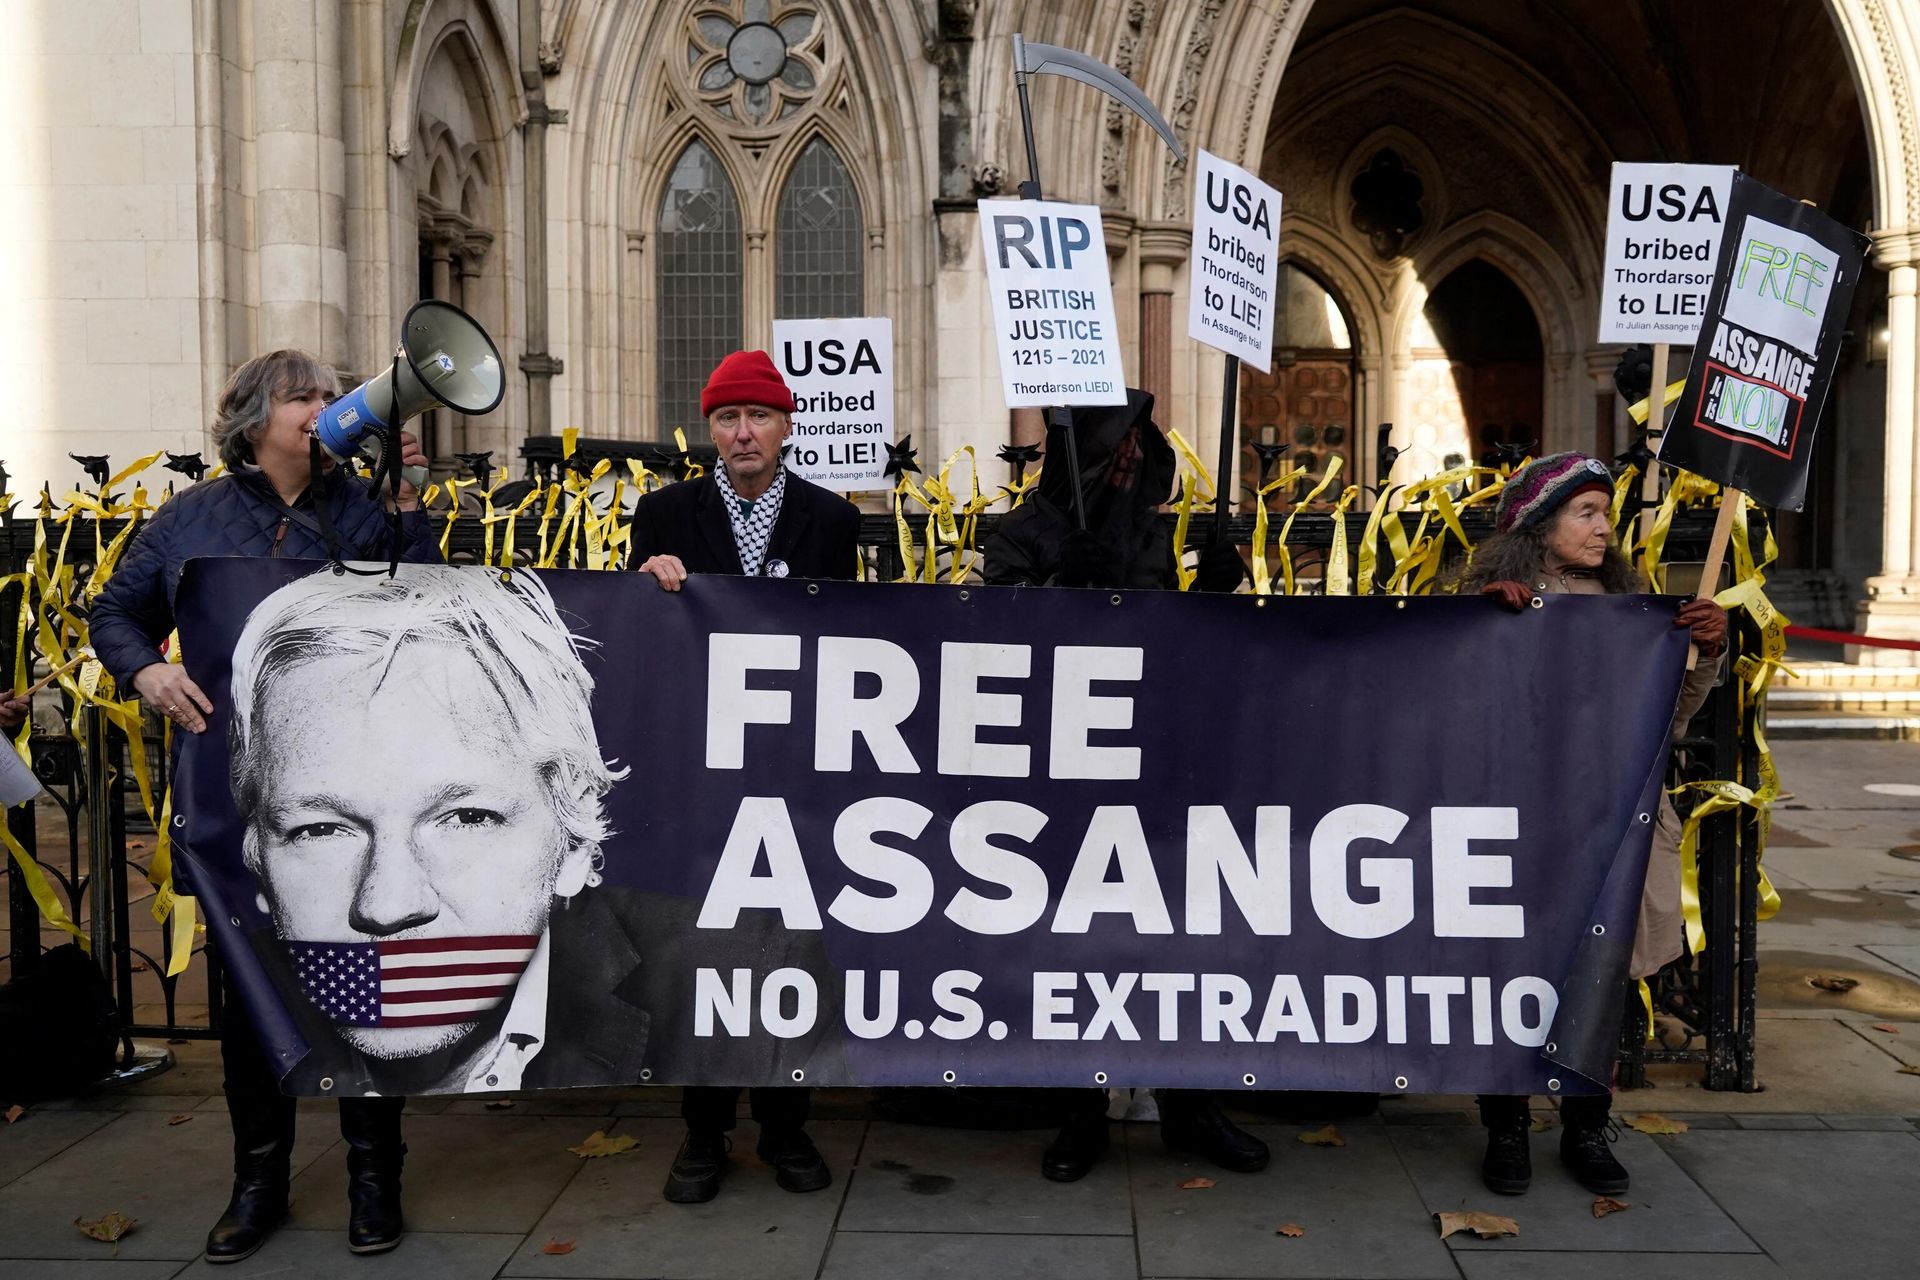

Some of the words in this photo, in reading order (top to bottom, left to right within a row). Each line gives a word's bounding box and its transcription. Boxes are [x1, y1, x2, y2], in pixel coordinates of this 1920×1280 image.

[1206, 171, 1272, 241] USA
[1621, 184, 1721, 223] USA
[993, 215, 1091, 270] RIP
[1208, 227, 1266, 275] bribed
[1624, 238, 1711, 262] bribed
[1201, 256, 1268, 302] Thordarson
[1737, 239, 1829, 318] FREE
[1007, 289, 1096, 311] BRITISH
[1204, 285, 1224, 311] to
[1231, 294, 1262, 331] LIE!
[1619, 293, 1645, 315] to
[1655, 294, 1705, 316] LIE!
[1009, 320, 1103, 341] JUSTICE
[1201, 313, 1210, 326] In
[1212, 318, 1248, 343] Assange
[1248, 336, 1262, 350] trial
[1615, 321, 1624, 330] In
[1626, 321, 1651, 330] Julian
[1653, 322, 1689, 333] Assange
[784, 339, 882, 377] USA
[1012, 349, 1053, 366] 1215
[1071, 349, 1106, 366] 2021
[1709, 321, 1816, 402] ASSANGE
[793, 390, 875, 414] bribed
[1012, 382, 1082, 396] Thordarson
[1084, 382, 1113, 394] LIED!
[1718, 378, 1788, 437] NOW
[794, 446, 819, 466] to
[828, 443, 877, 465] LIE!
[804, 472, 826, 480] Julian
[829, 471, 864, 481] Assange
[865, 469, 880, 478] trial
[706, 633, 1143, 779] FREE
[696, 797, 1525, 939] ASSANGE
[694, 967, 818, 1039] NO
[844, 969, 1008, 1040] U.S.
[1032, 972, 1560, 1048] EXTRADITIO
